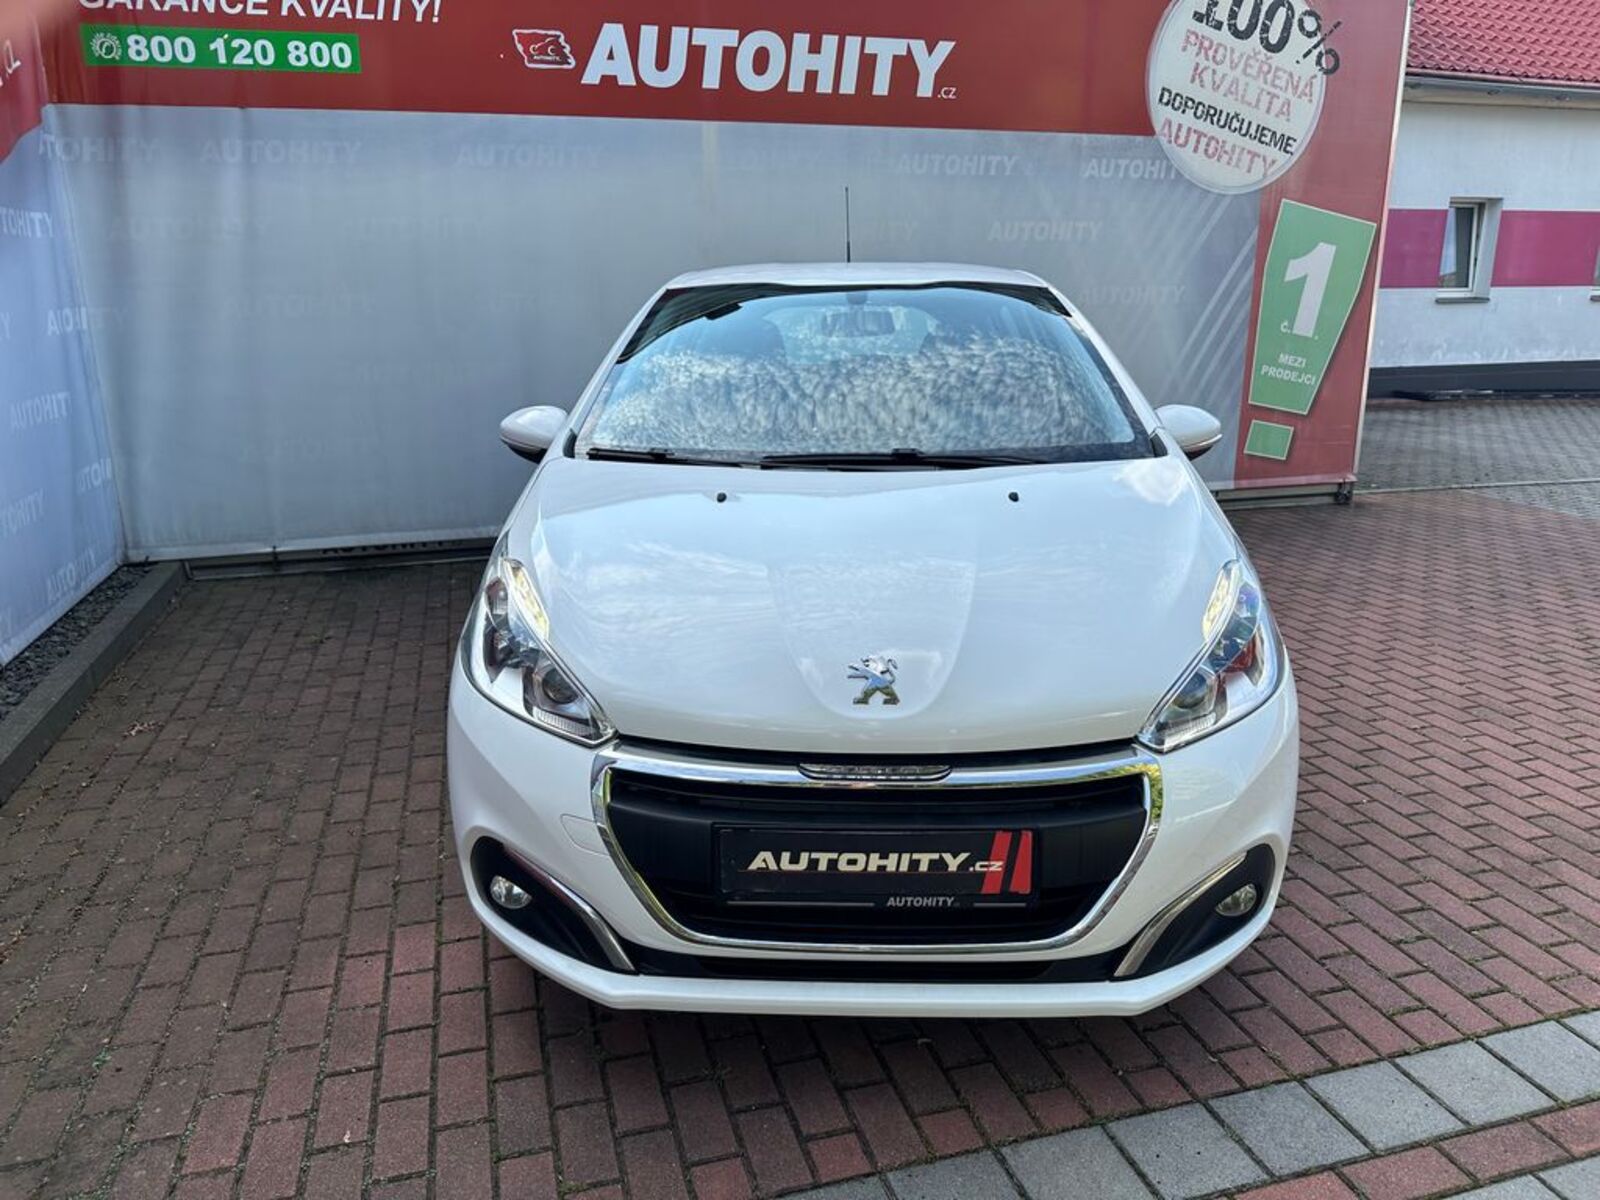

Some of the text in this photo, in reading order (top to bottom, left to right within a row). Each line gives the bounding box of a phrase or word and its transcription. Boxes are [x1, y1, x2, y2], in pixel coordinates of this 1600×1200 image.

[280, 0, 442, 23] KVALITY!
[1192, 0, 1342, 75] 100%
[127, 34, 197, 63] 800
[208, 34, 276, 66] 120
[287, 40, 352, 68] 800
[1181, 28, 1318, 103] PROVĚŘENÁ
[1189, 61, 1292, 122] KVALITA
[1158, 86, 1297, 156] DOPORUČUJEME
[455, 141, 601, 169] AUTOHITY
[1160, 117, 1278, 179] AUTOHITY
[895, 152, 1021, 177] AUTOHITY
[988, 221, 1103, 242] AUTOHITY
[1278, 352, 1306, 368] MEZI
[1261, 364, 1317, 386] PRODEJCI
[747, 850, 1005, 873] AUTOHITY.cz
[886, 896, 954, 908] AUTOHITY
